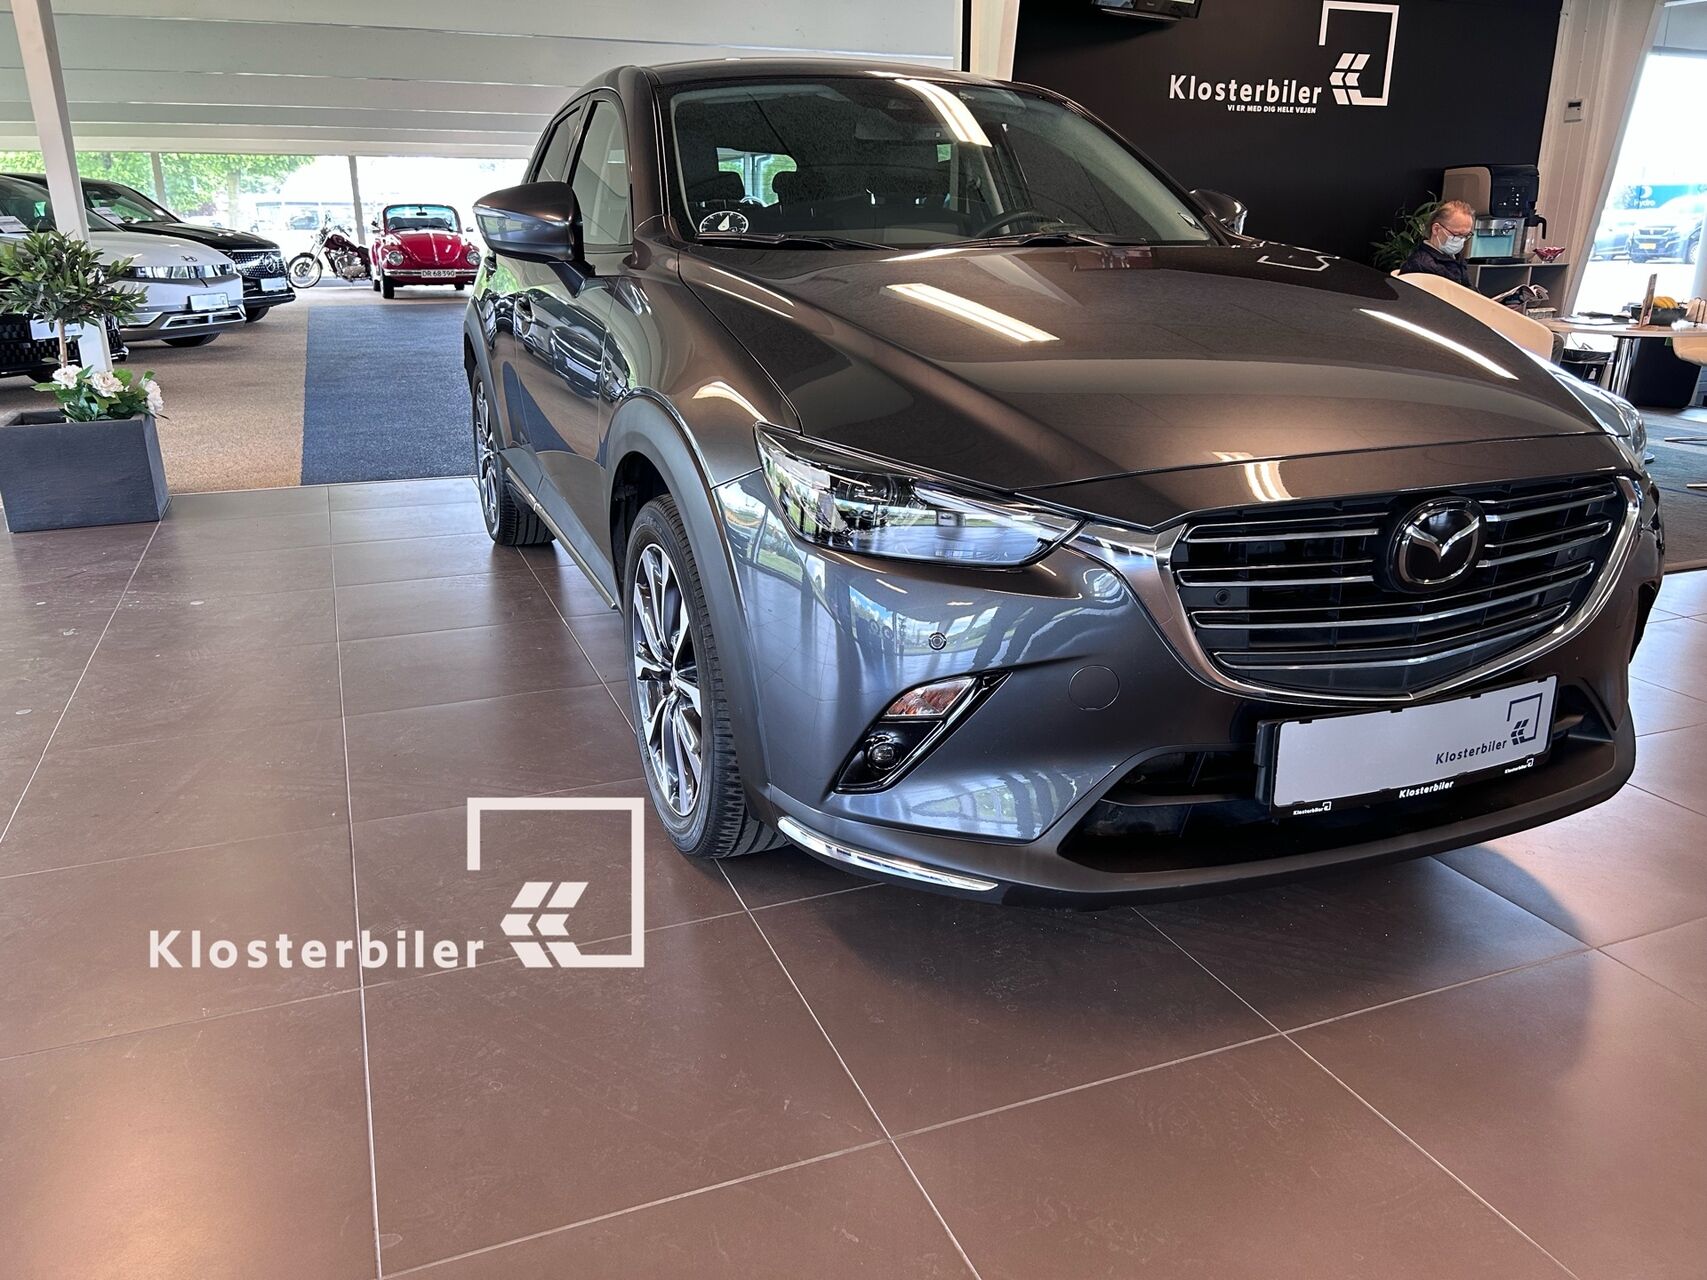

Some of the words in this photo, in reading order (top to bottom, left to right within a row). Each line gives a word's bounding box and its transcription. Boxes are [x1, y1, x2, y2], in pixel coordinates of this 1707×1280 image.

[1169, 74, 1322, 104] Klosterbiler
[1227, 104, 1235, 112] VI
[1263, 105, 1276, 113] DIG
[1295, 106, 1317, 114] VEJEN
[1435, 739, 1507, 765] Klosterbiler
[1398, 780, 1454, 799] Klosterbiler
